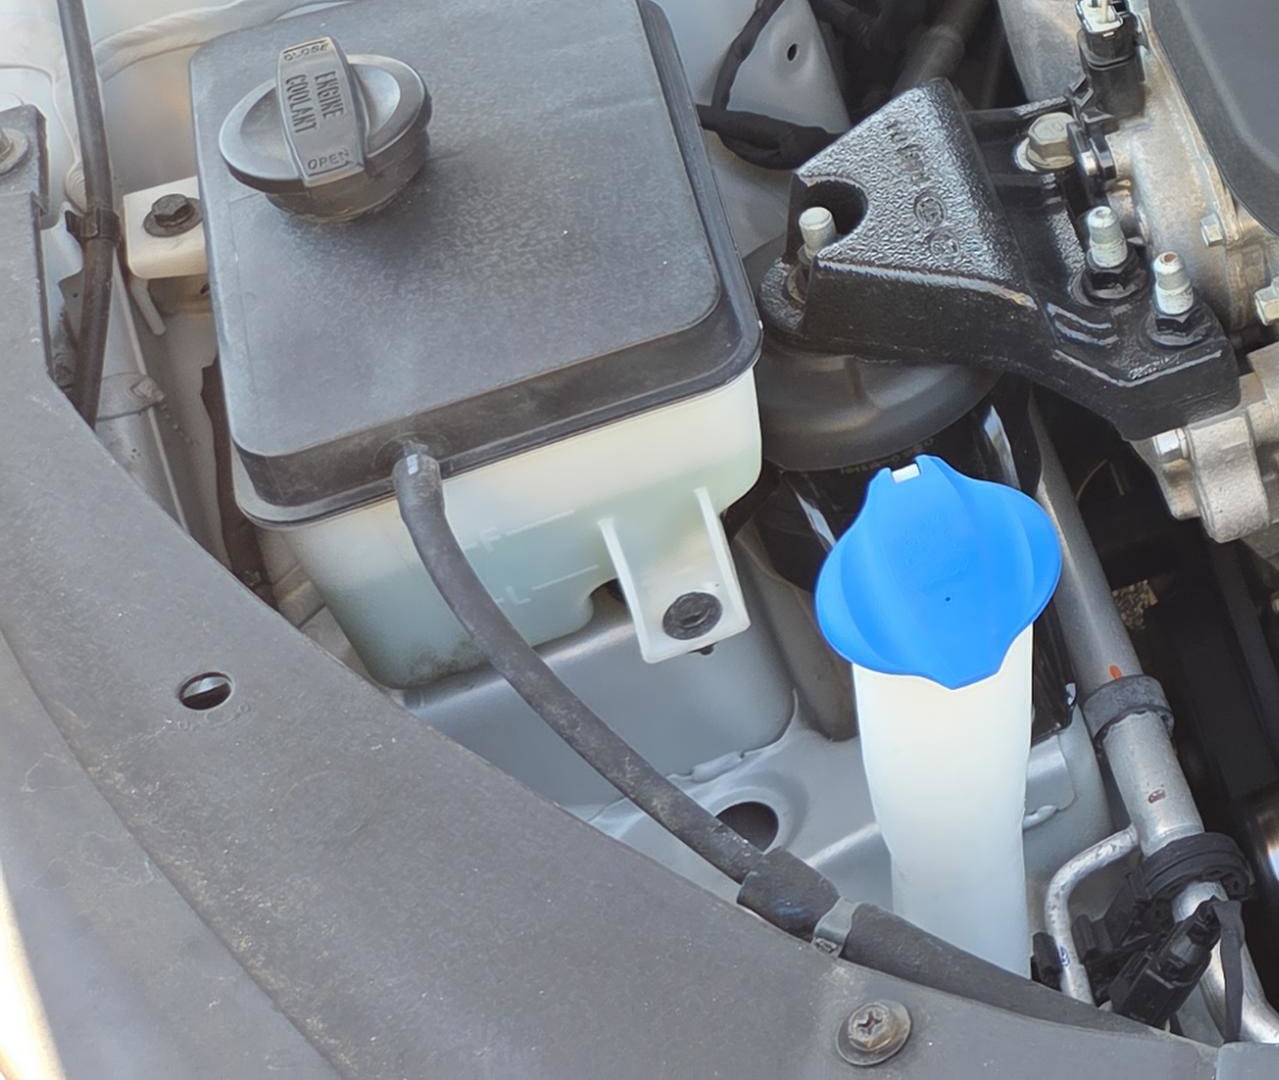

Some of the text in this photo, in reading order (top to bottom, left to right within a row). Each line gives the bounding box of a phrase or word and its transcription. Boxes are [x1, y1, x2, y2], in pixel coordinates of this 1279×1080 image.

[283, 42, 330, 62] CLOSE
[286, 73, 318, 133] COOLANT
[313, 69, 345, 119] ENGINE
[306, 149, 350, 171] OPEN
[479, 526, 502, 553] F
